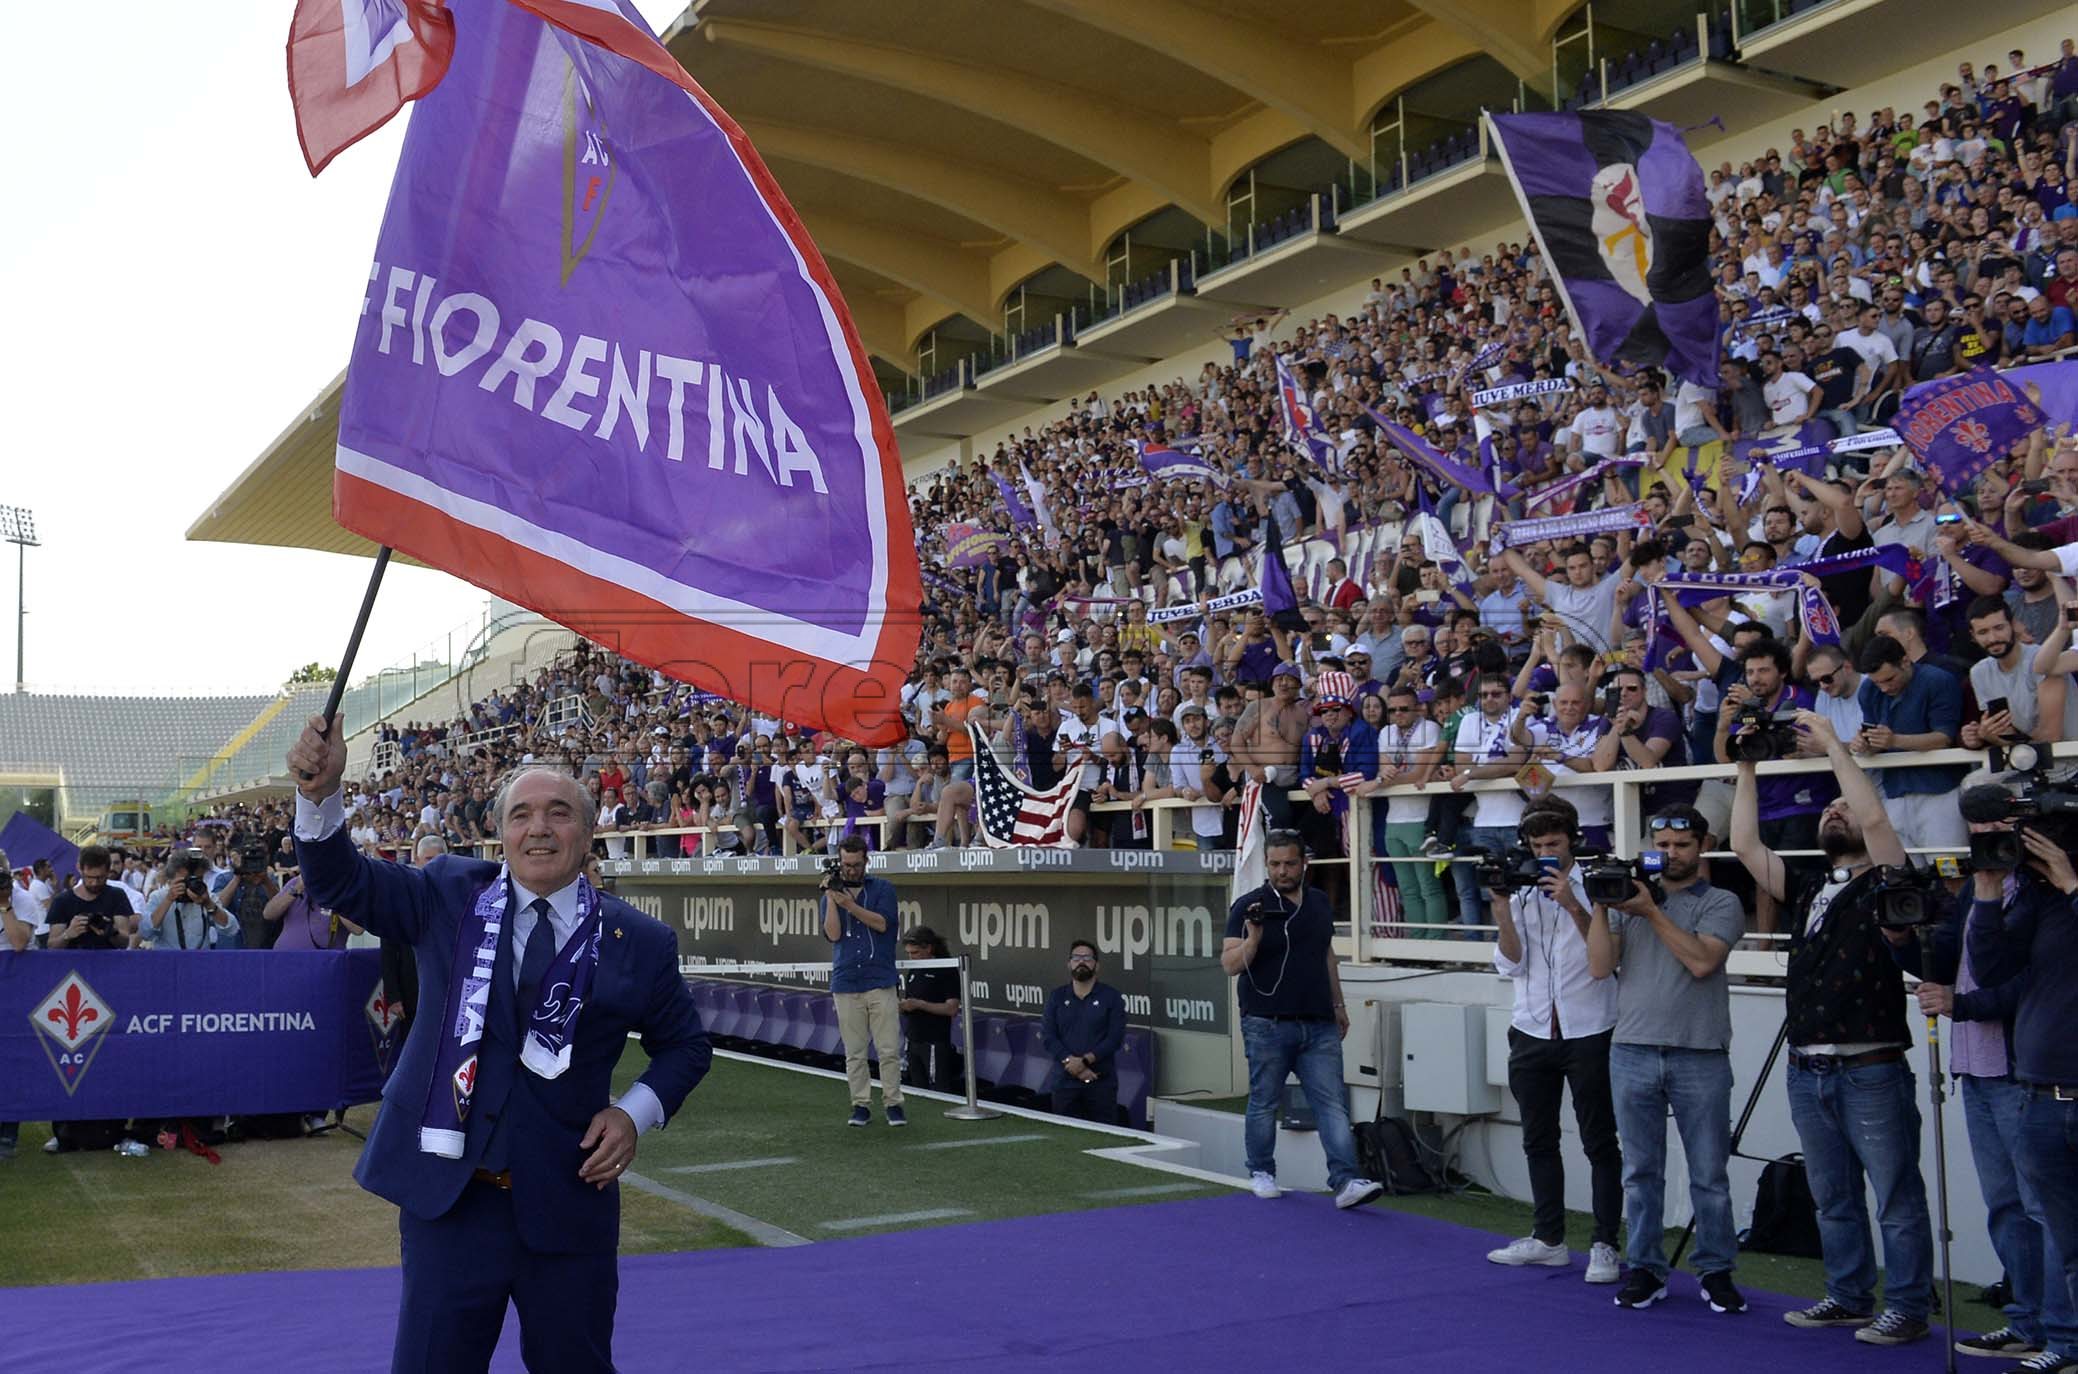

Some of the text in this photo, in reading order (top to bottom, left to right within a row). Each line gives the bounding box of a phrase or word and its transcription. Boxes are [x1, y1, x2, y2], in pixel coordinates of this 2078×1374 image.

[378, 266, 829, 496] FIORENTINA
[1513, 378, 1570, 397] MERDA
[1147, 590, 1263, 623] JUVE ERDA
[671, 859, 691, 876] upim
[703, 858, 724, 875] upim
[737, 858, 760, 875] upim
[774, 857, 799, 874] upim
[866, 853, 888, 873] pim
[906, 852, 938, 872] upim
[960, 850, 994, 870] upim
[1018, 848, 1072, 869] upim
[1110, 850, 1164, 871] upim
[1200, 852, 1235, 872] upi
[683, 896, 734, 940] upim
[759, 898, 819, 945] upim
[959, 902, 1050, 960] upim
[1096, 905, 1213, 970] upim
[1006, 983, 1043, 1008] upim
[1165, 997, 1215, 1025] upim
[126, 1012, 316, 1034] ACF FIORENTINA
